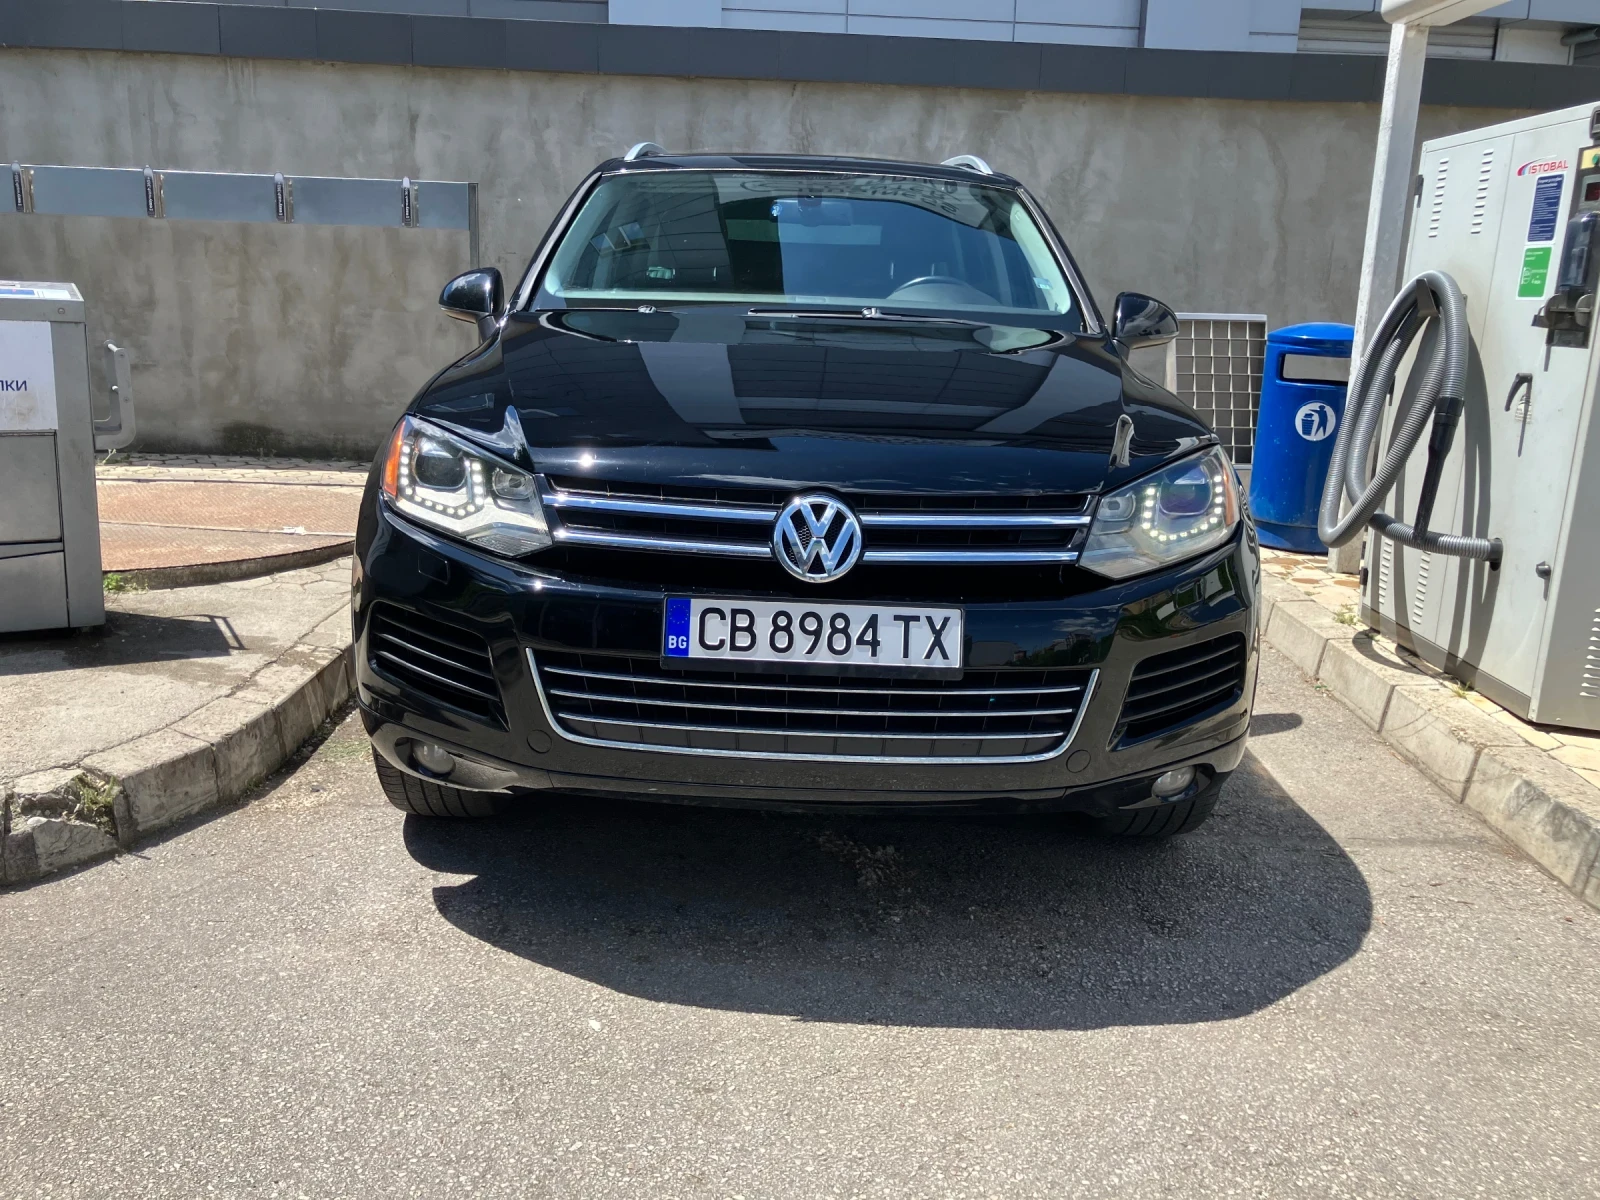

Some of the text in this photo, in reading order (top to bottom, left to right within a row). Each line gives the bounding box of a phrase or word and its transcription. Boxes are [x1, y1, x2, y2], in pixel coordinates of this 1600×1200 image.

[1528, 160, 1569, 175] ISTOBAL
[698, 607, 951, 660] CB 8984 TX
[667, 635, 687, 650] BG
